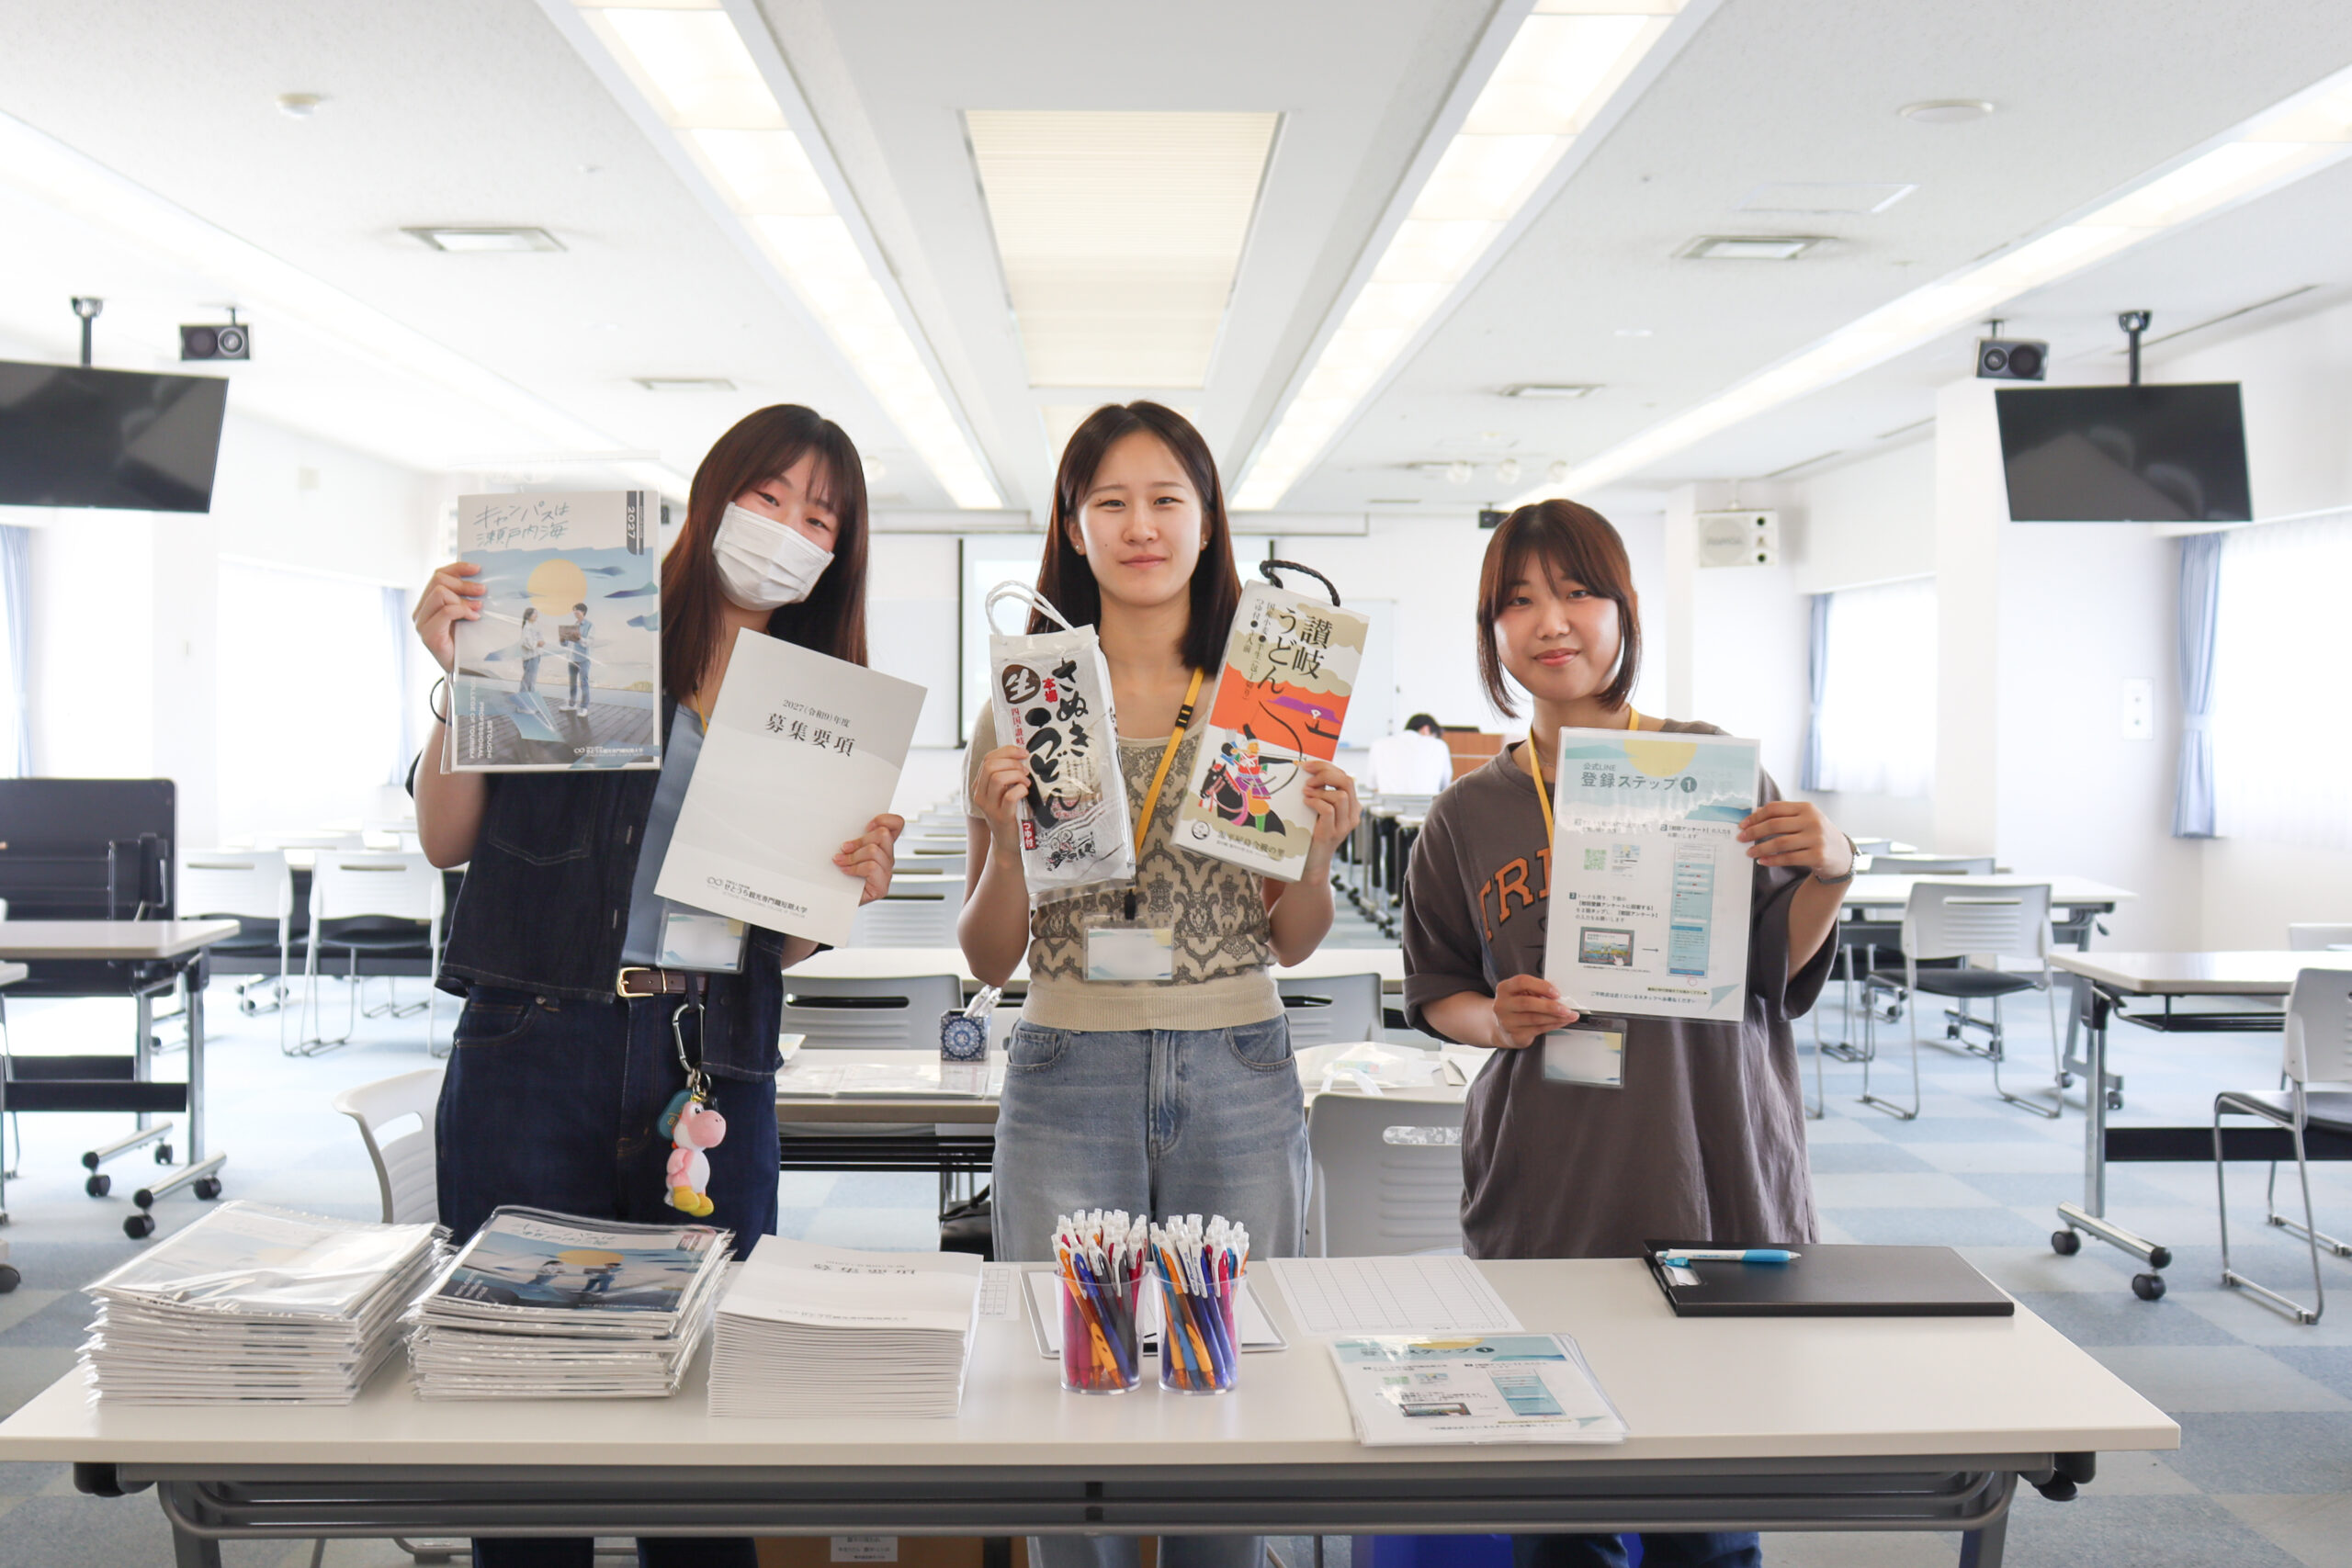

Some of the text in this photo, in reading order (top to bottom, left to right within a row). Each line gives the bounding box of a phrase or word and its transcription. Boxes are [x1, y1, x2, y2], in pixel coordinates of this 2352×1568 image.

[473, 501, 570, 528] キャンパスは
[628, 506, 636, 539] 2027
[476, 520, 570, 548] 瀬戸内海
[1258, 607, 1297, 694] うどん
[1004, 667, 1037, 702] 生
[1052, 658, 1089, 757] さぬき
[765, 713, 855, 757] 募集要項
[1025, 707, 1081, 829] うどん
[1583, 762, 1616, 772] 公式LINE
